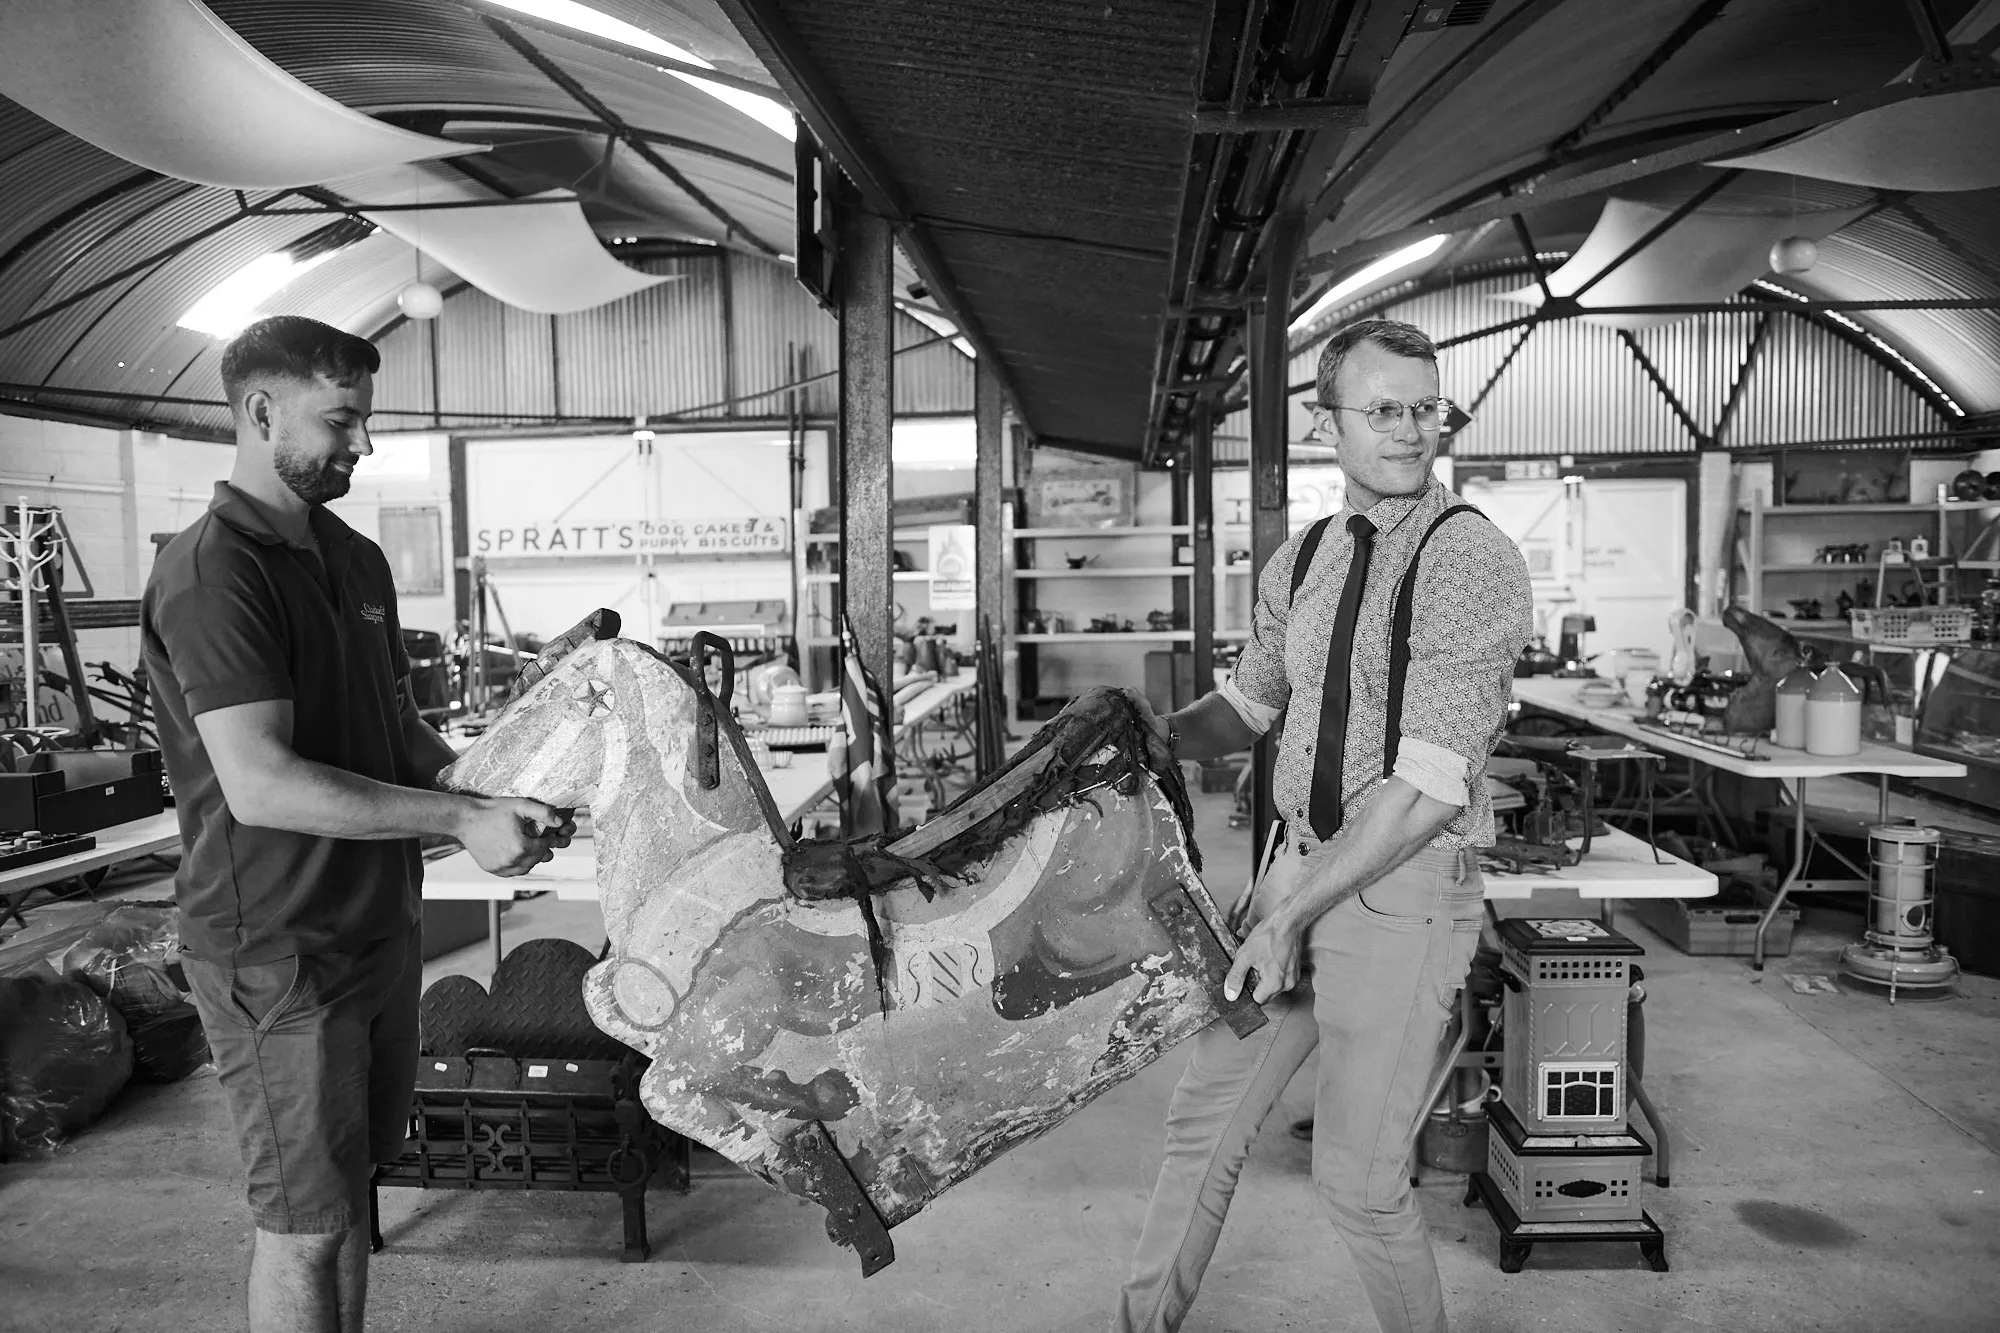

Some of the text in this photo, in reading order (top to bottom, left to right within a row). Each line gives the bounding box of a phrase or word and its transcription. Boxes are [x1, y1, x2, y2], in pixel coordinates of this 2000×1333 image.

[644, 523, 774, 537] DOG CAKES &
[478, 525, 633, 551] SPRATT'S
[640, 535, 780, 548] PUPPY BISCUITS
